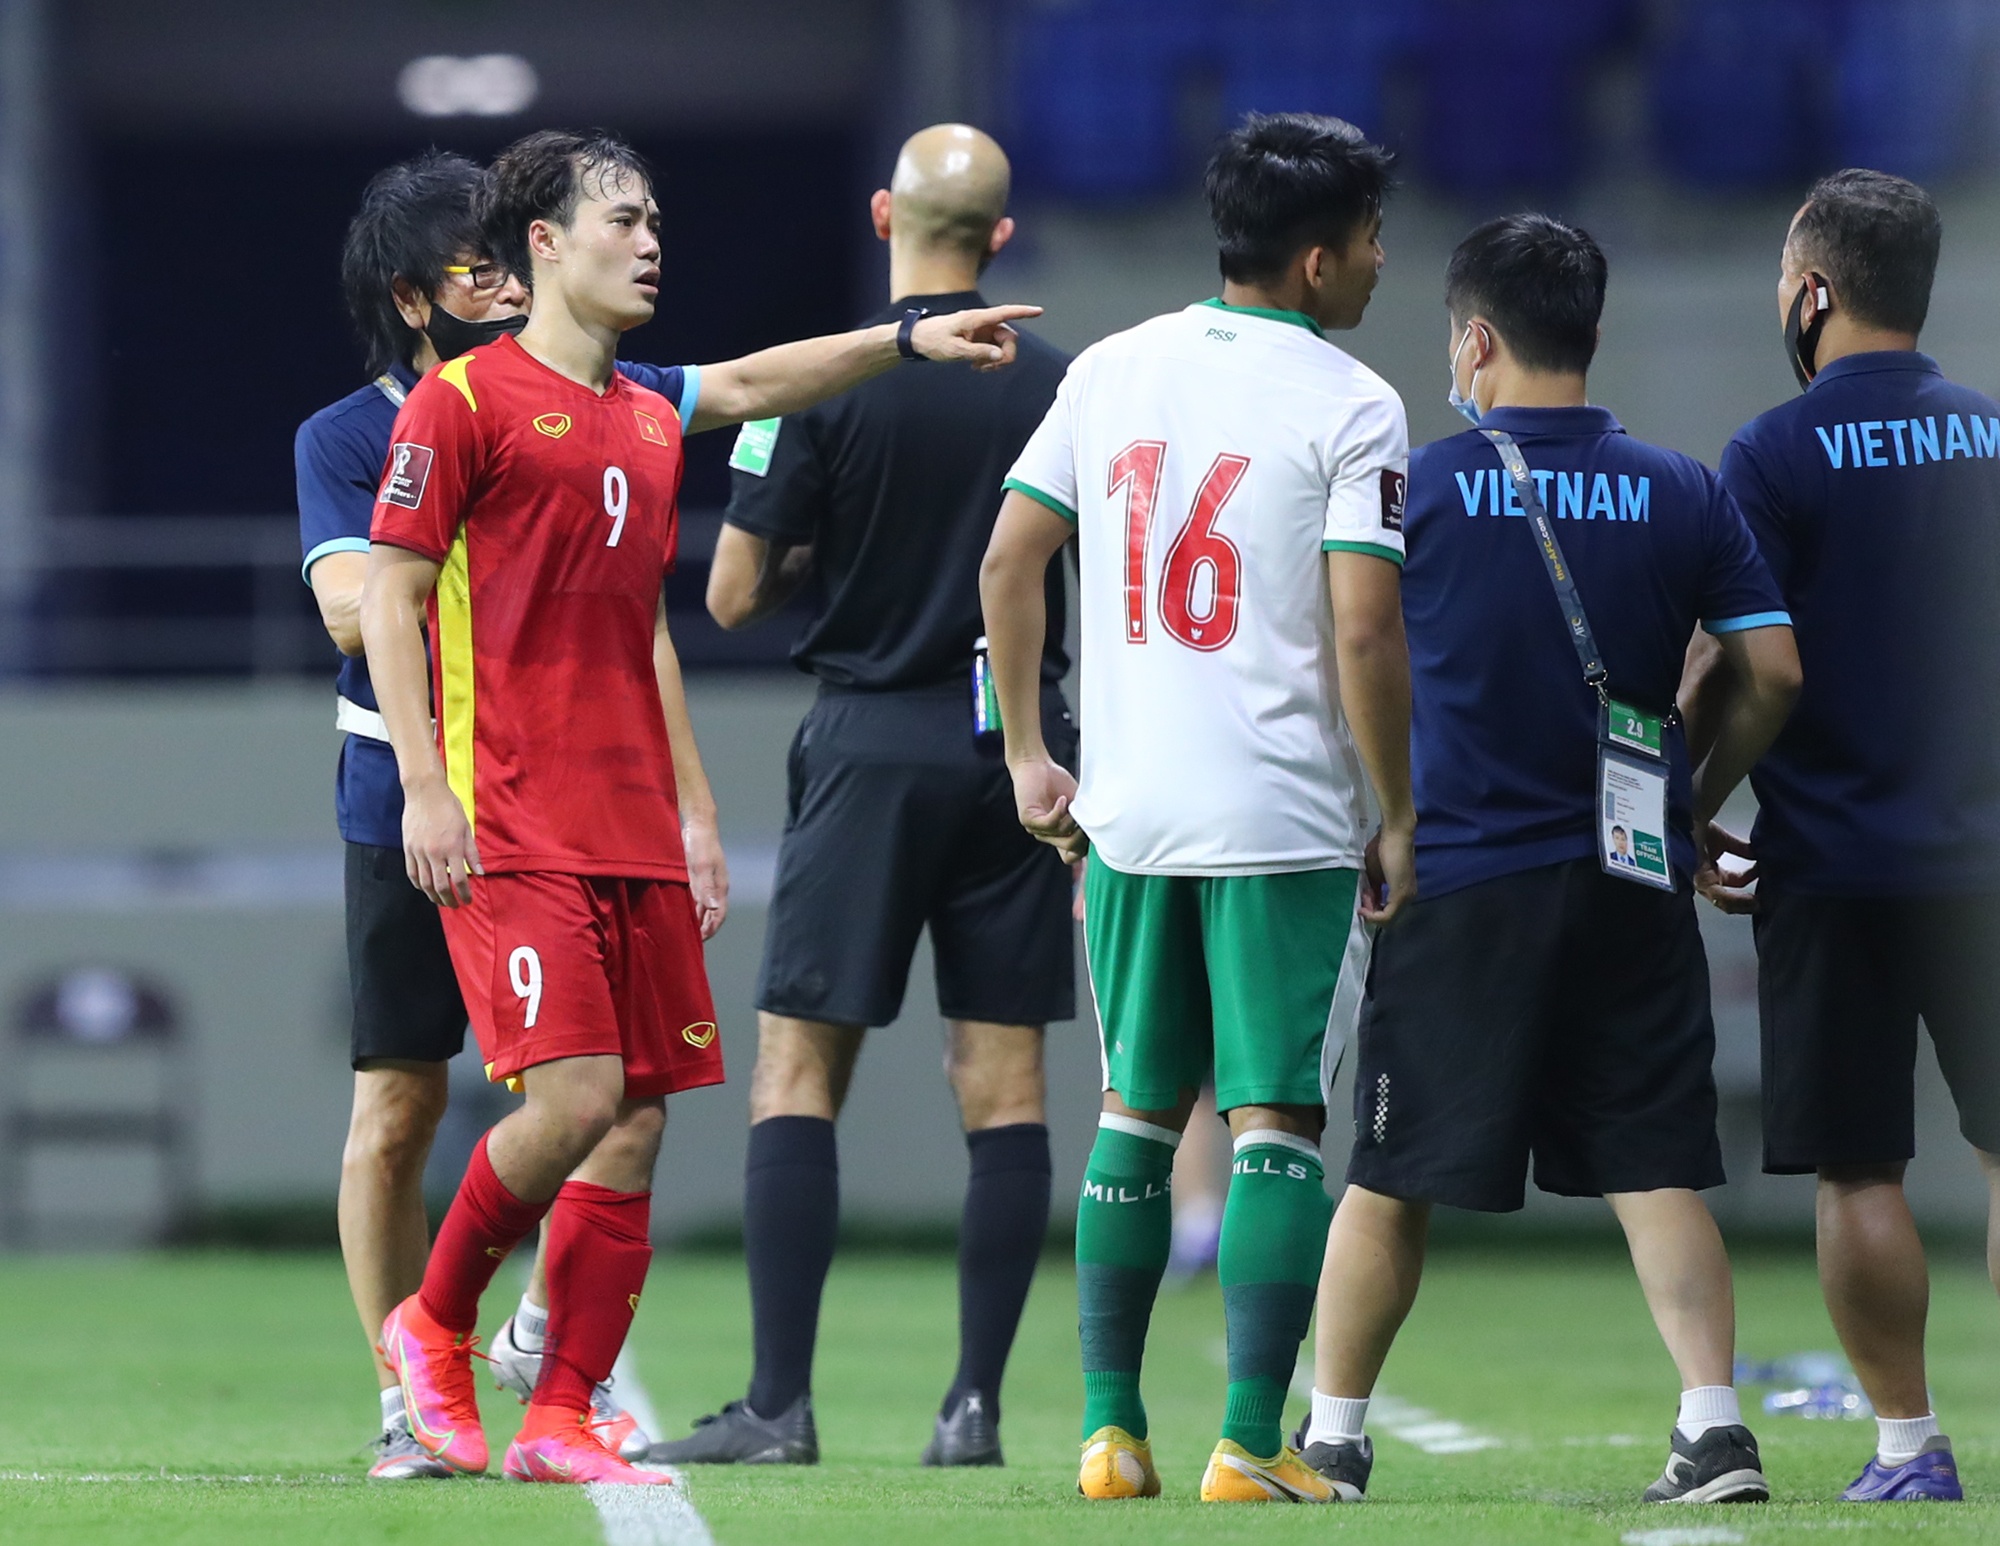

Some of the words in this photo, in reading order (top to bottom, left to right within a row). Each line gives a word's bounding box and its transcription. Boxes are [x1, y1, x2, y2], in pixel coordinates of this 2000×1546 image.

[1205, 328, 1237, 342] PSSI
[1815, 413, 2000, 469] VIETNAM
[603, 465, 629, 547] 9
[1455, 469, 1650, 523] VIETNAM
[1107, 440, 1251, 653] 16
[1627, 718, 1644, 739] 2.9
[1636, 849, 1664, 864] OFFICIAL
[508, 945, 543, 1029] 9
[1233, 1158, 1307, 1180] ILLS
